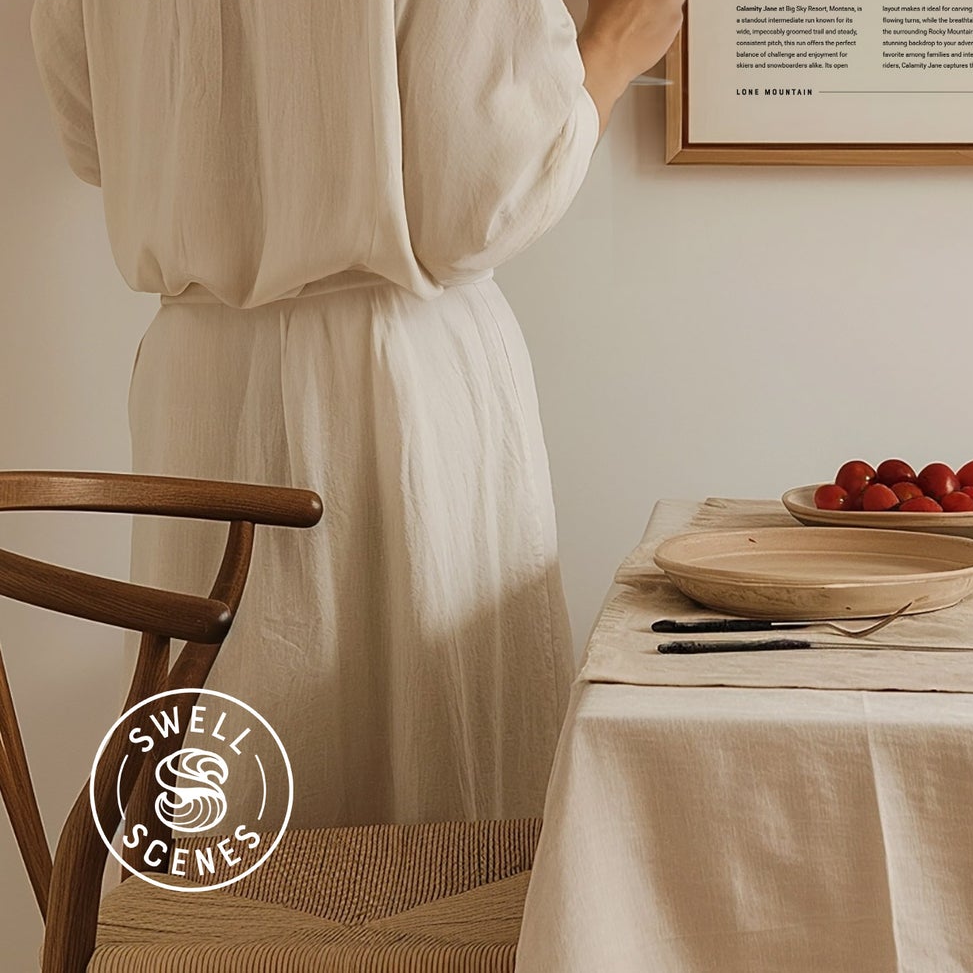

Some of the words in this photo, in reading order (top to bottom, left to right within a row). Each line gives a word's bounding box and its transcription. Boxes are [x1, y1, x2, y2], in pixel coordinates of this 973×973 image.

[785, 5, 795, 13] Big
[882, 17, 904, 25] flowing
[752, 28, 785, 36] impeccably
[837, 28, 858, 36] steady,
[928, 28, 946, 36] Rocky
[901, 62, 927, 70] Calamity
[736, 88, 759, 96] LONE
[764, 88, 813, 96] MOUNTAIN
